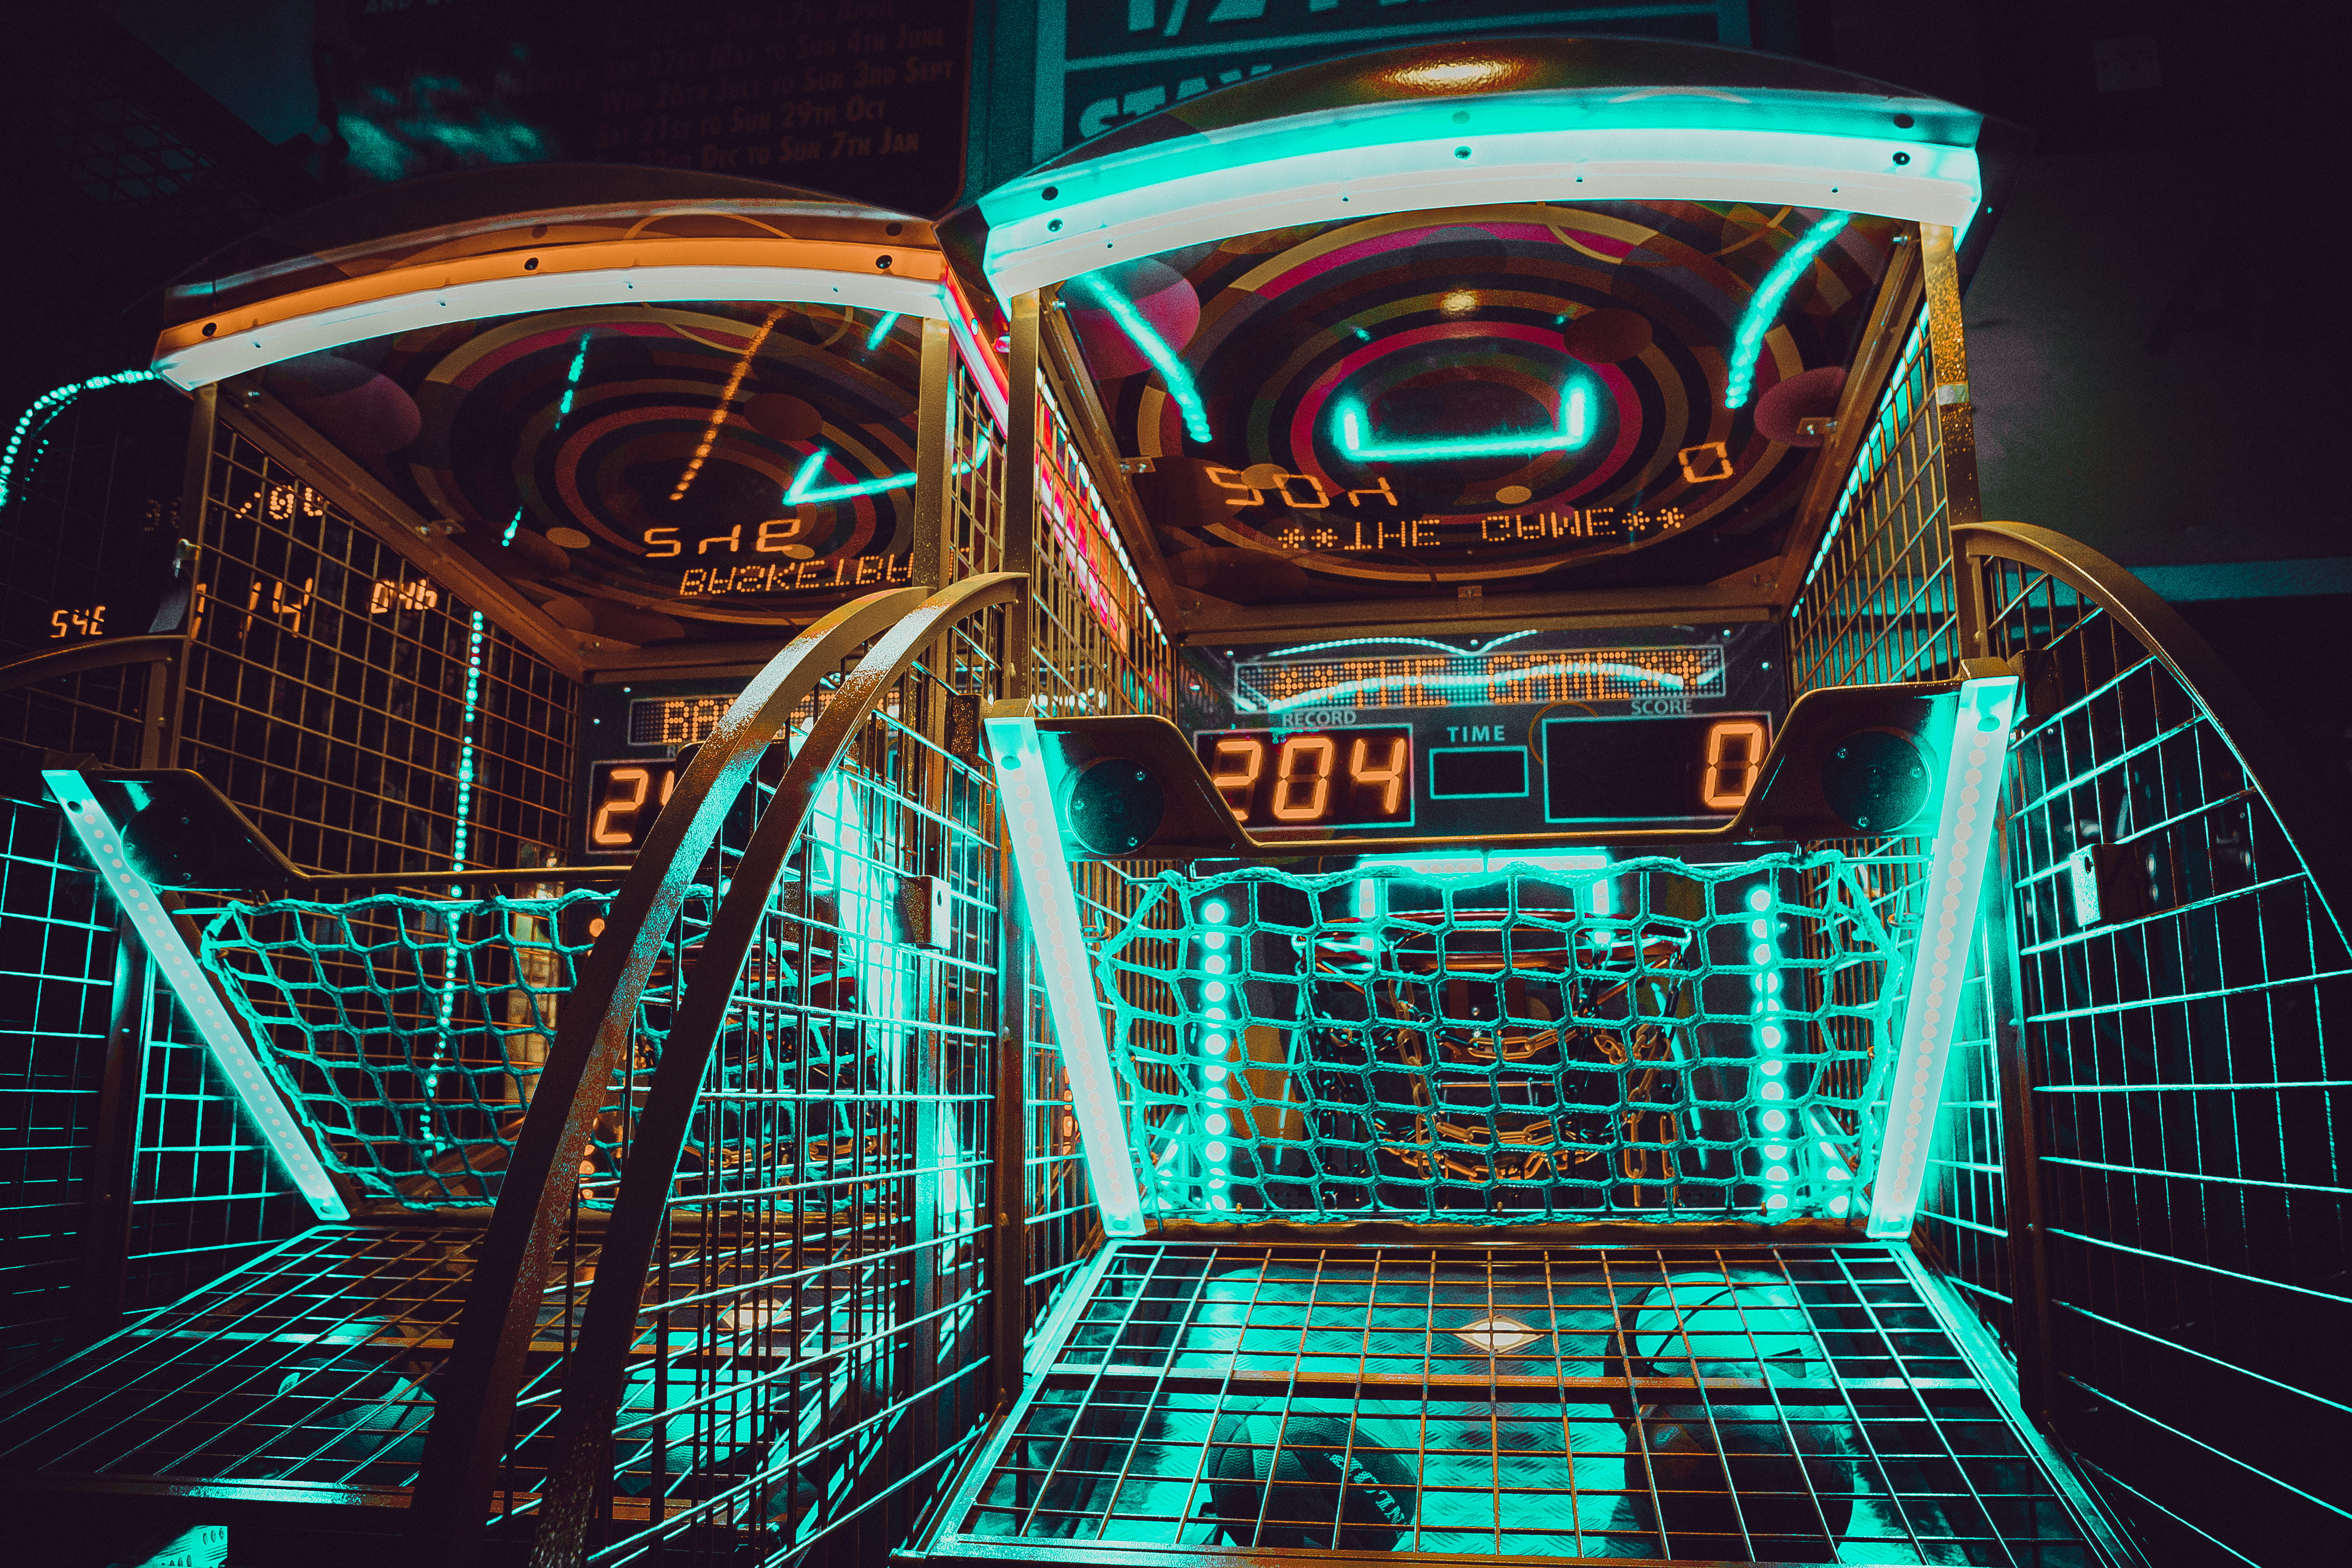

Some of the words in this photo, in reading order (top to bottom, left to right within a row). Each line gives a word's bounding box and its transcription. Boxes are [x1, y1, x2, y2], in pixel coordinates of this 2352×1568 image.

[830, 130, 871, 158] 7TH
[879, 126, 920, 154] JAN
[1631, 699, 1693, 715] SCORE
[1282, 711, 1357, 728] RECORD
[1447, 725, 1506, 742] TIME
[1212, 737, 1406, 820] 204
